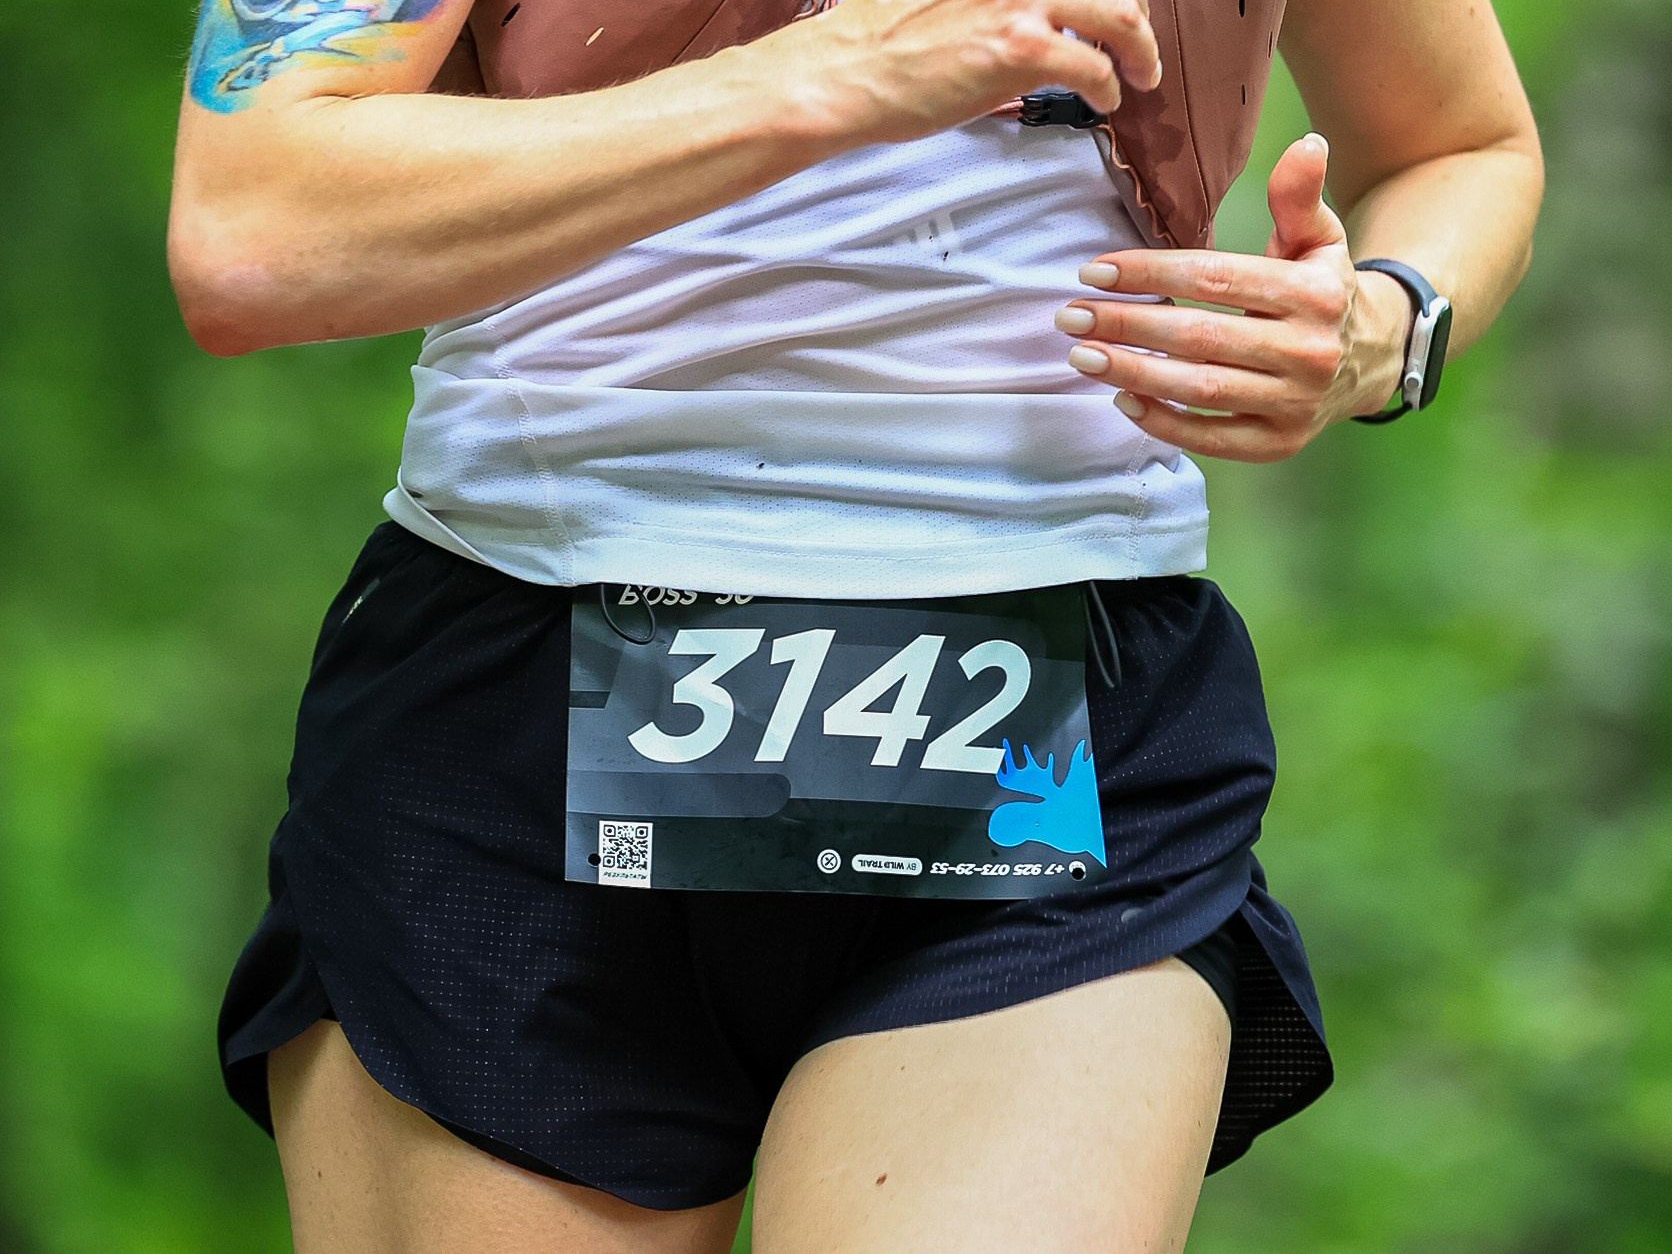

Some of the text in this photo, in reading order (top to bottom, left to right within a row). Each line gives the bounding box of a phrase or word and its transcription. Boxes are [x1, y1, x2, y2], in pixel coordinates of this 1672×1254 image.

[627, 628, 1032, 775] 3142
[857, 859, 917, 871] BY WILD TRAIL
[929, 861, 1065, 876] +7 925 073-29-53
